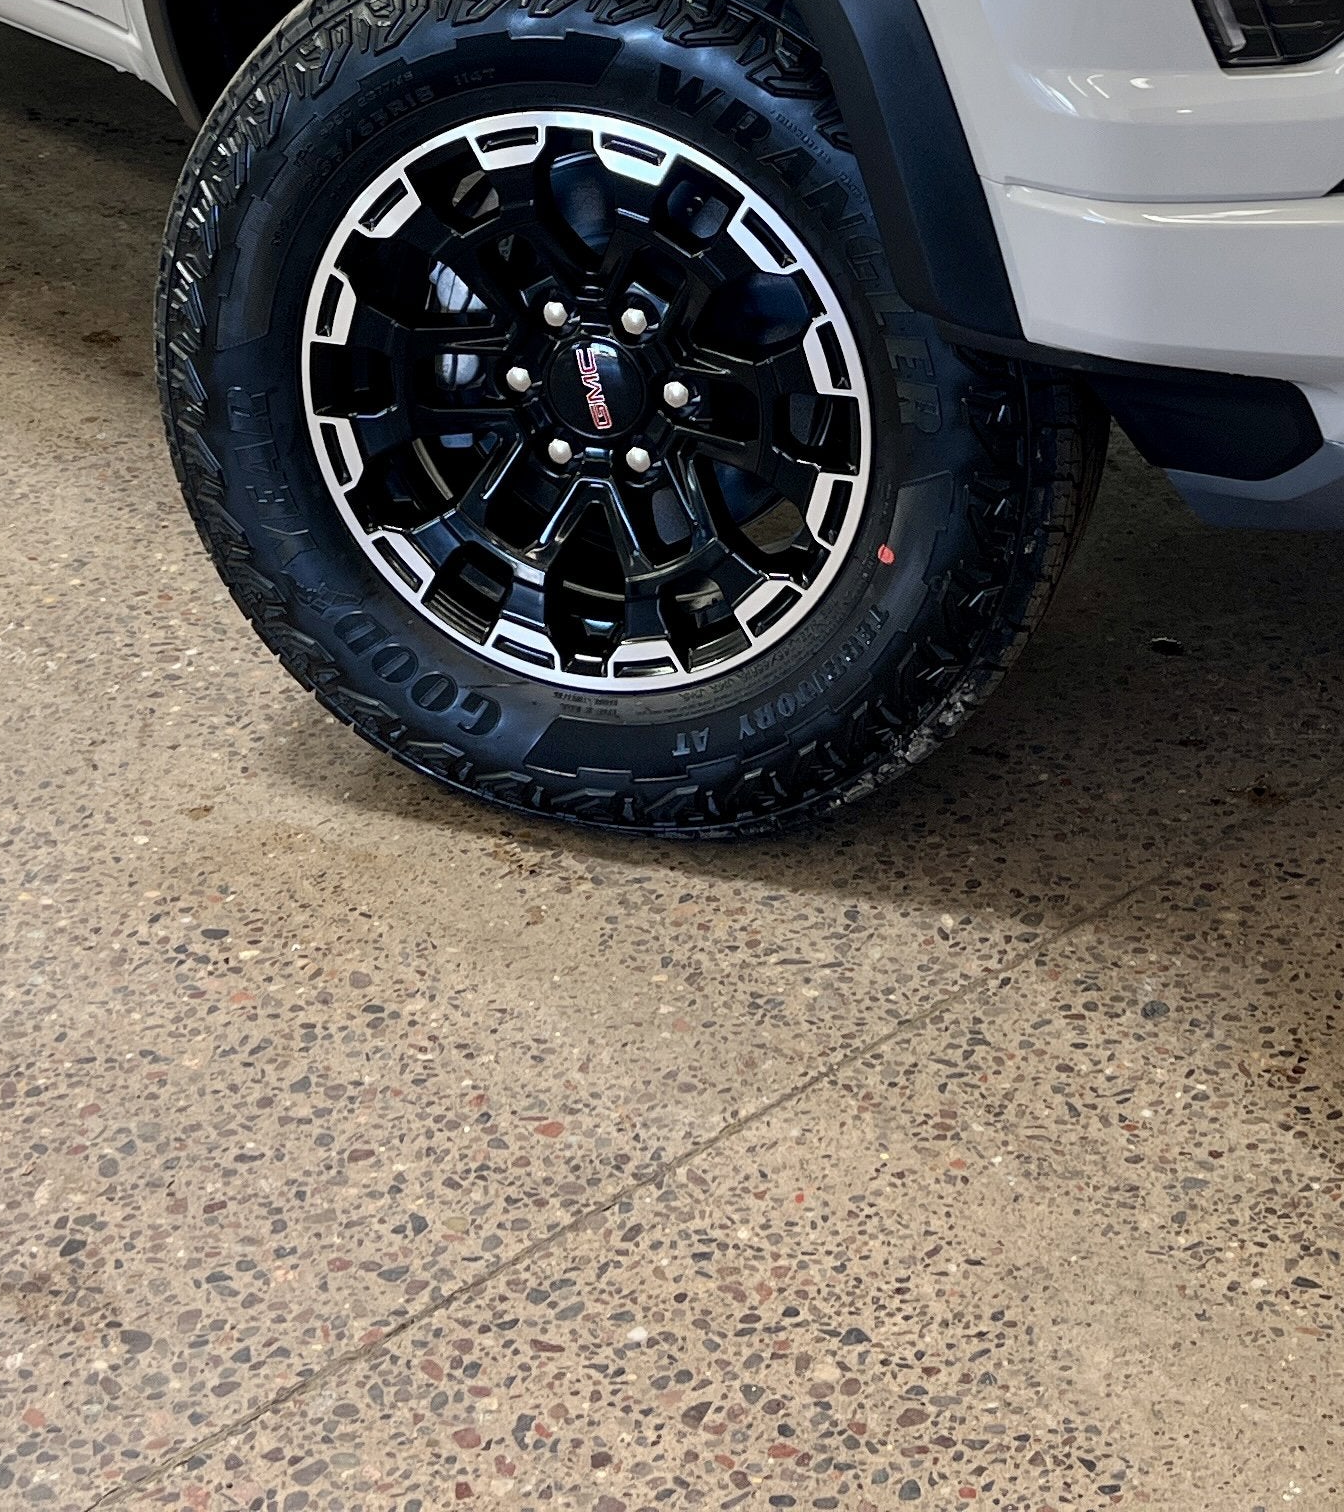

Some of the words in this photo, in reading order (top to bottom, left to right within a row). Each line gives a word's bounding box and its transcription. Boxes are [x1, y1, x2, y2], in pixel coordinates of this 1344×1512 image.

[656, 63, 943, 434] WRANGLER
[576, 347, 613, 429] GMC
[333, 609, 503, 737] GOOD
[739, 603, 890, 739] TERRITORY
[672, 727, 709, 757] AT
